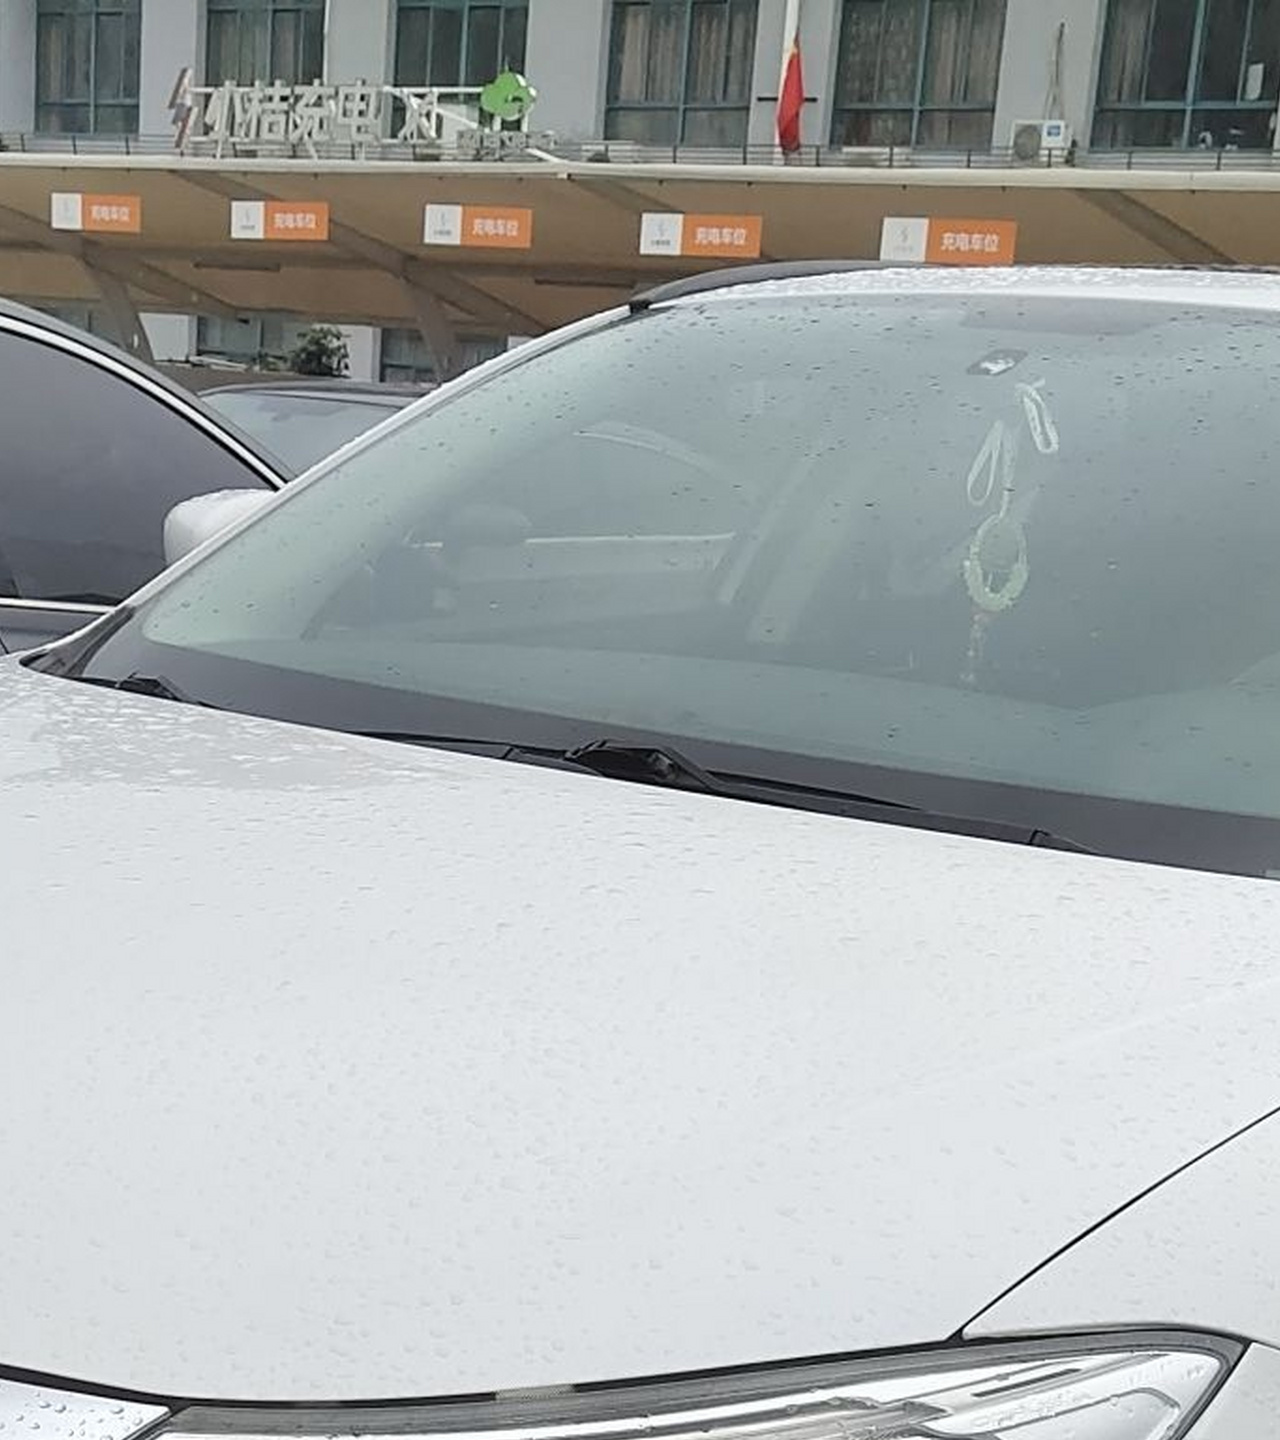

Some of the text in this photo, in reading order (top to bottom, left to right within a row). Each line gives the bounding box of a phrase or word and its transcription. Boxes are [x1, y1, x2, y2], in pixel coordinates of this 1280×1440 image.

[693, 226, 747, 246] 充电车位
[940, 231, 1001, 253] 充电车位
